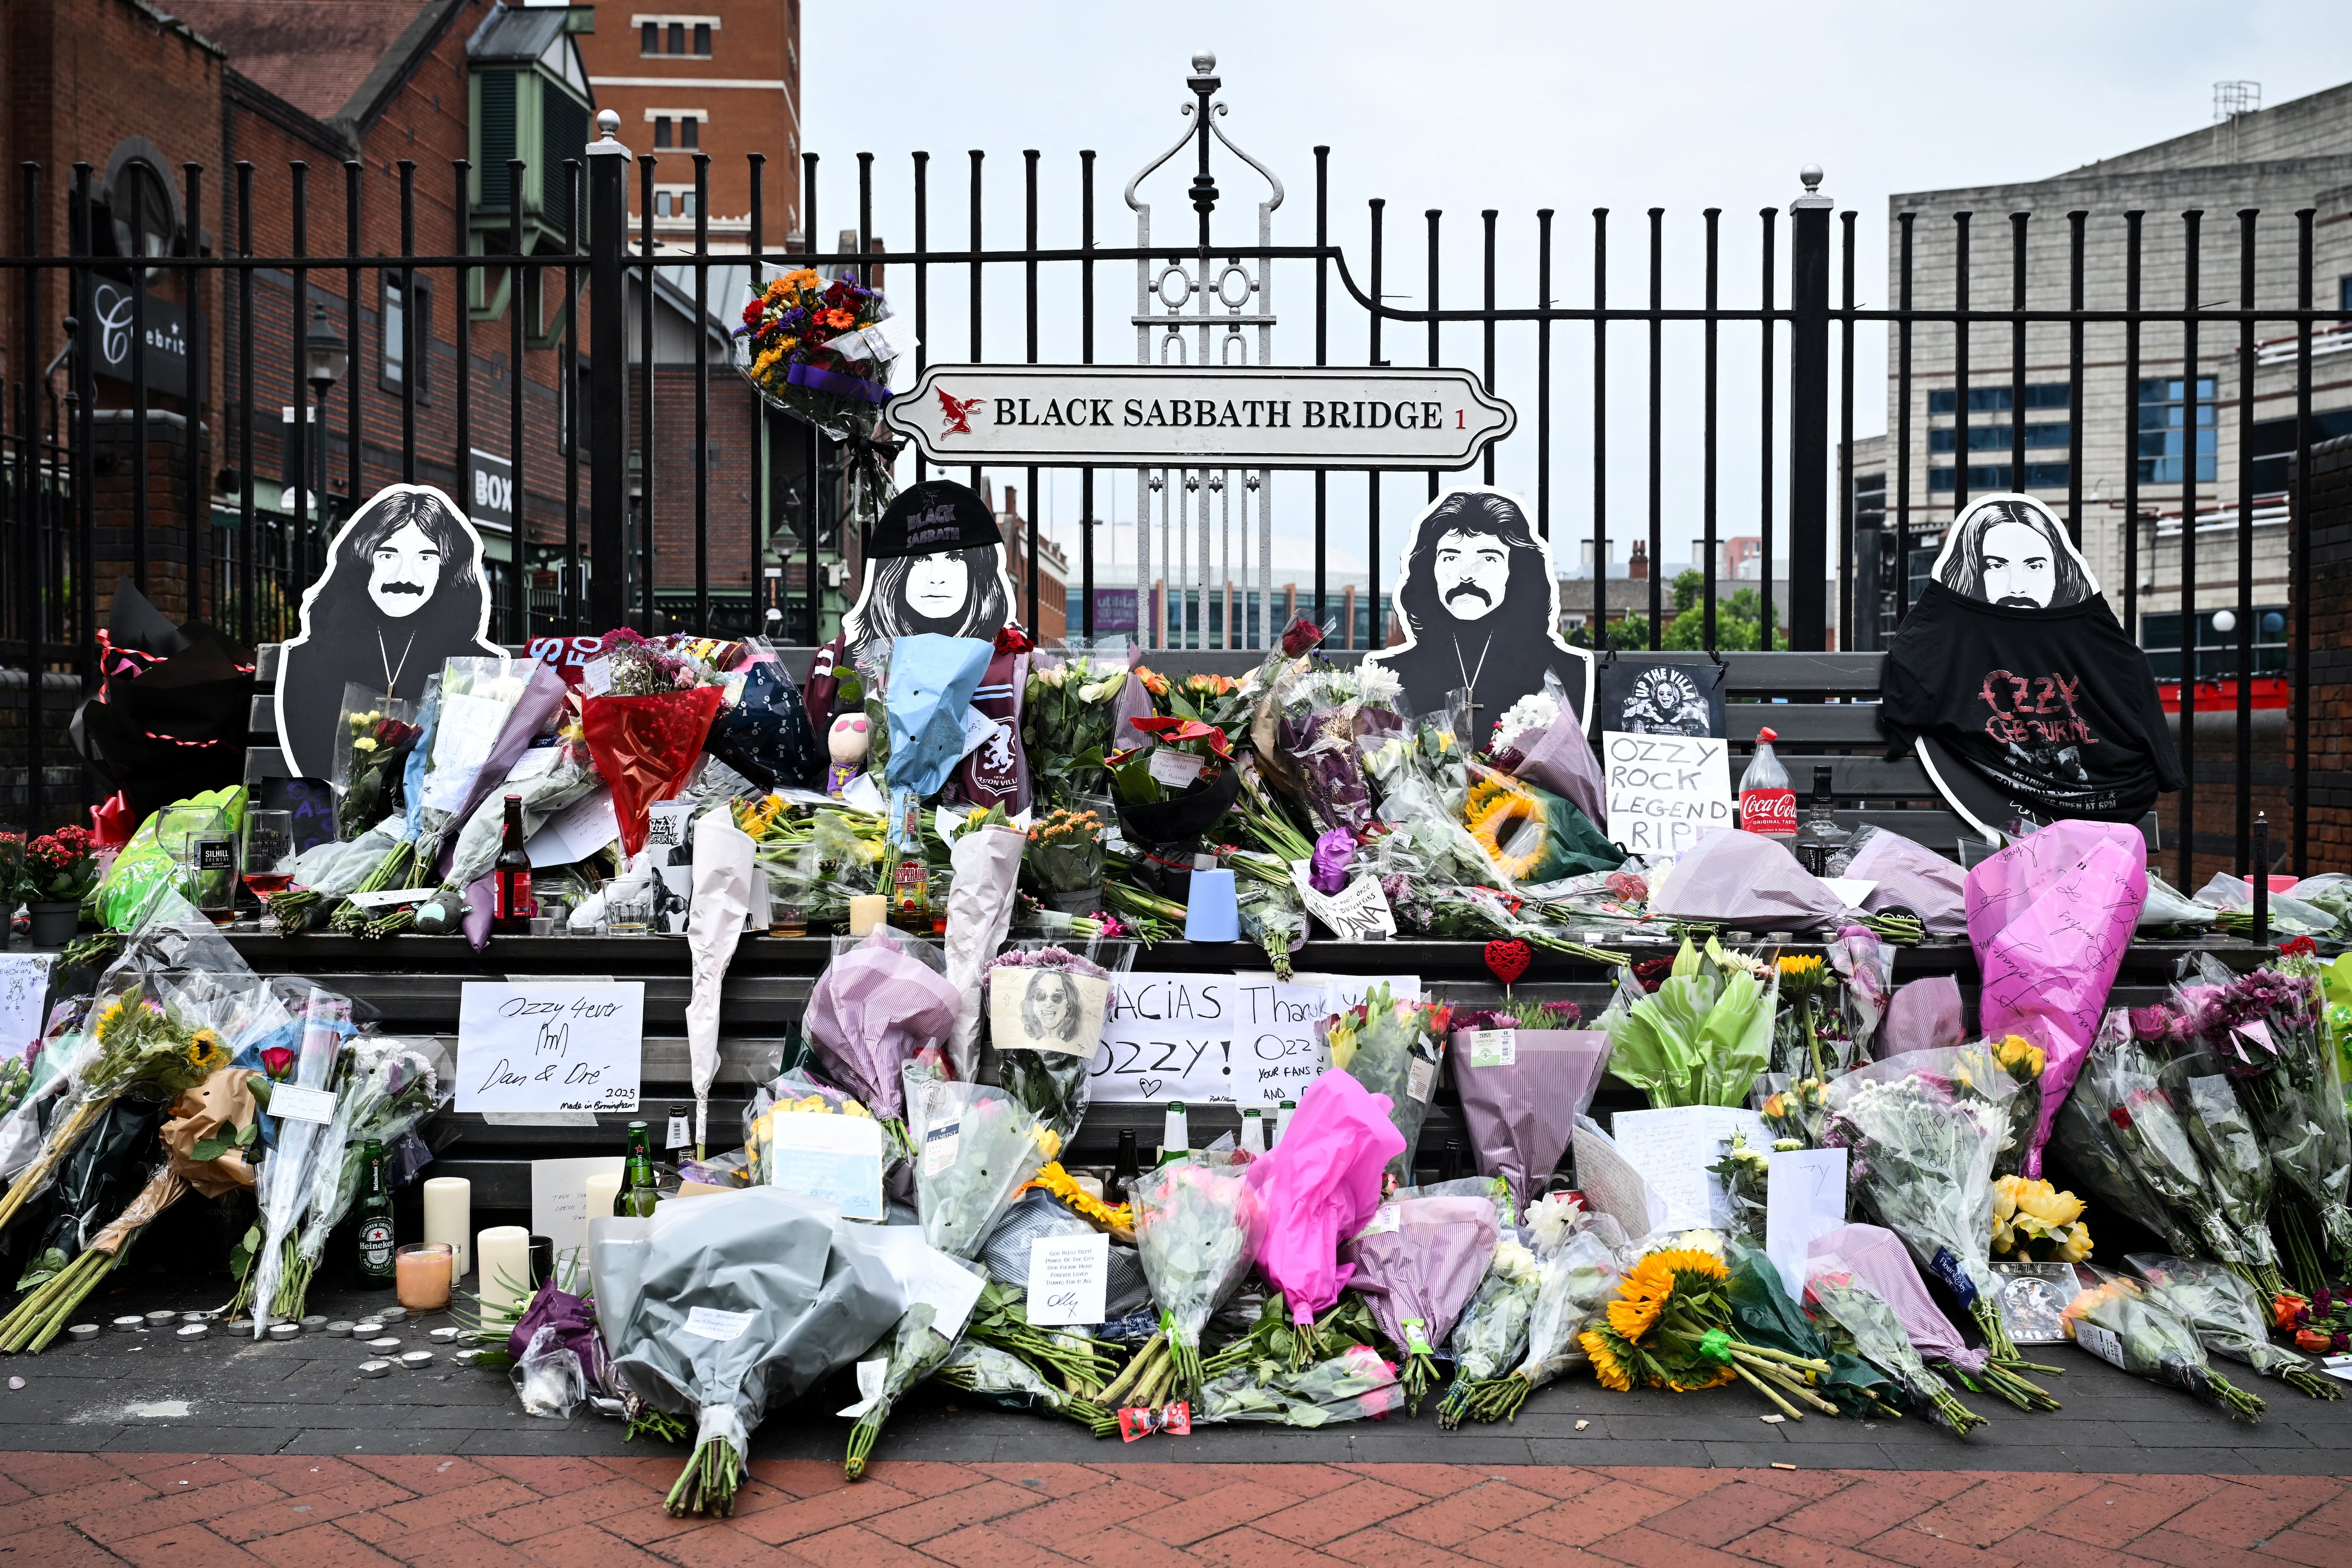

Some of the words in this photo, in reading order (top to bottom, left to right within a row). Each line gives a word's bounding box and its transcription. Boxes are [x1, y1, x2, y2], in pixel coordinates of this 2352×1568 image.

[95, 284, 185, 363] Cebrit
[824, 378, 874, 398] OZZY
[994, 398, 1115, 427] BLACK
[1123, 398, 1290, 428] SABBATH
[1303, 400, 1443, 430] BRIDGE
[1455, 408, 1467, 430] 1
[475, 470, 512, 513] BOX
[907, 504, 956, 533] BLACK
[906, 527, 960, 548] SABBATH
[1635, 681, 1650, 698] UP
[1643, 668, 1667, 684] THE
[1670, 669, 1696, 700] VILLA
[1155, 754, 1169, 763] Ozzy
[1611, 738, 1719, 766] OZZY
[1160, 762, 1172, 771] heavy
[977, 776, 999, 786] ASTON
[1168, 772, 1190, 781] Australia
[1612, 766, 1701, 790] ROCK
[1611, 793, 1727, 819] LEGEND
[2098, 800, 2116, 810] 6PM
[649, 815, 677, 835] ZZY
[261, 832, 281, 841] OLD
[262, 840, 291, 848] MOUT
[650, 833, 680, 846] BOURNE
[1632, 821, 1691, 851] RIP
[1825, 853, 1836, 865] JACK
[895, 868, 927, 882] DESPERADOS
[1356, 883, 1371, 897] onze
[1340, 901, 1363, 914] DUTCH
[1362, 892, 1376, 904] FANS
[16, 958, 32, 967] from
[499, 997, 565, 1025] Ozzy
[571, 996, 623, 1018] 4ever
[1240, 986, 1331, 1024] Thank
[477, 1059, 527, 1094] Dan
[535, 1065, 557, 1082] &
[1258, 1066, 1279, 1082] YOUR
[1284, 1066, 1311, 1076] FANS
[605, 1088, 635, 1099] 2025
[1263, 1088, 1285, 1100] AND
[594, 1101, 635, 1113] Birmingham
[929, 1130, 958, 1142] FLORIST
[1915, 1114, 1946, 1148] RIP
[1928, 1134, 1966, 1168] OZZY
[361, 1223, 378, 1238] HEINEKEN
[379, 1222, 392, 1235] ORIGINAL
[359, 1239, 394, 1250] Heineken
[363, 1258, 372, 1269] PURE
[384, 1255, 393, 1267] LAGER
[2000, 1263, 2042, 1273] OZZY
